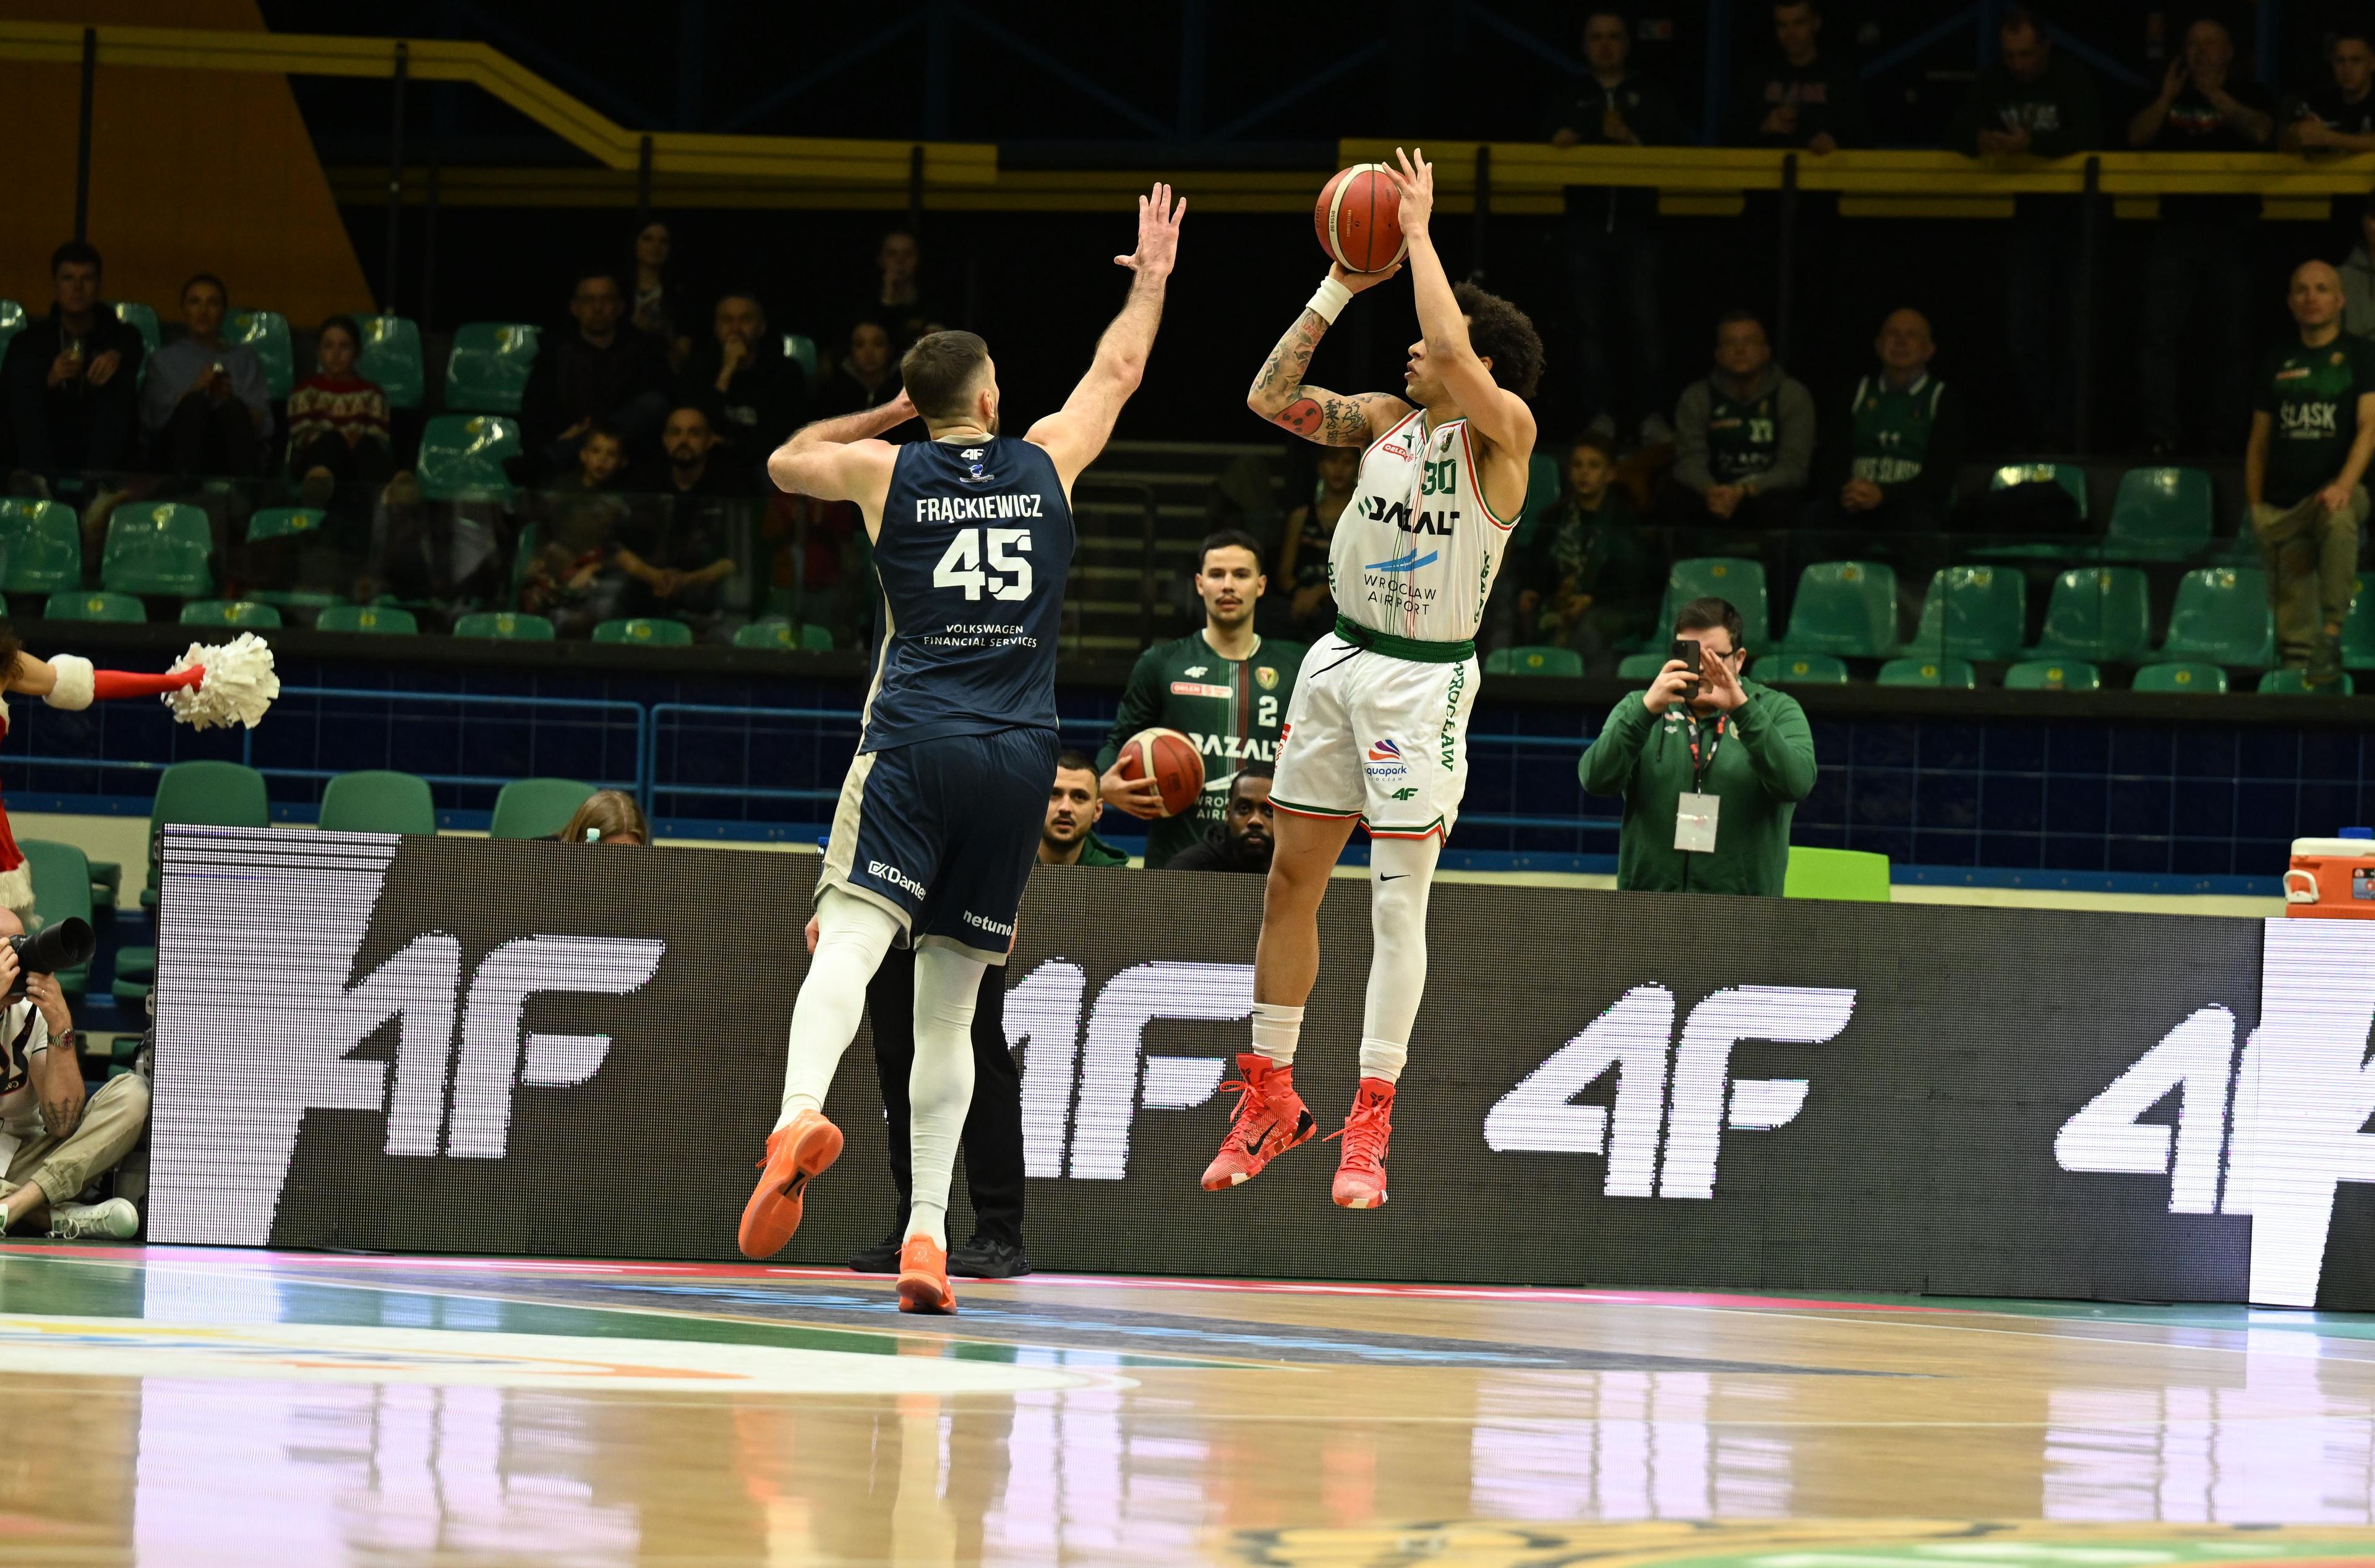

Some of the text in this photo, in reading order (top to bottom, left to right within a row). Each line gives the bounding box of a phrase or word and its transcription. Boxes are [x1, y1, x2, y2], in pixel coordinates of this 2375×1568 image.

[961, 448, 984, 460] 4F
[1421, 458, 1457, 496] 30
[916, 494, 1043, 523] FRĄCKIEWICZ
[933, 528, 1033, 601] 45
[1364, 573, 1437, 600] WROCLAW
[1367, 590, 1430, 615] AIRPORT
[946, 624, 1024, 634] VOLKSWAGEN
[924, 636, 1037, 648] FINANCIAL SERVICES
[1184, 666, 1209, 678] 4F
[1258, 695, 1278, 728] 2
[1364, 765, 1407, 777] quapark
[1391, 787, 1419, 801] 4F
[1484, 981, 1857, 1199] 4F
